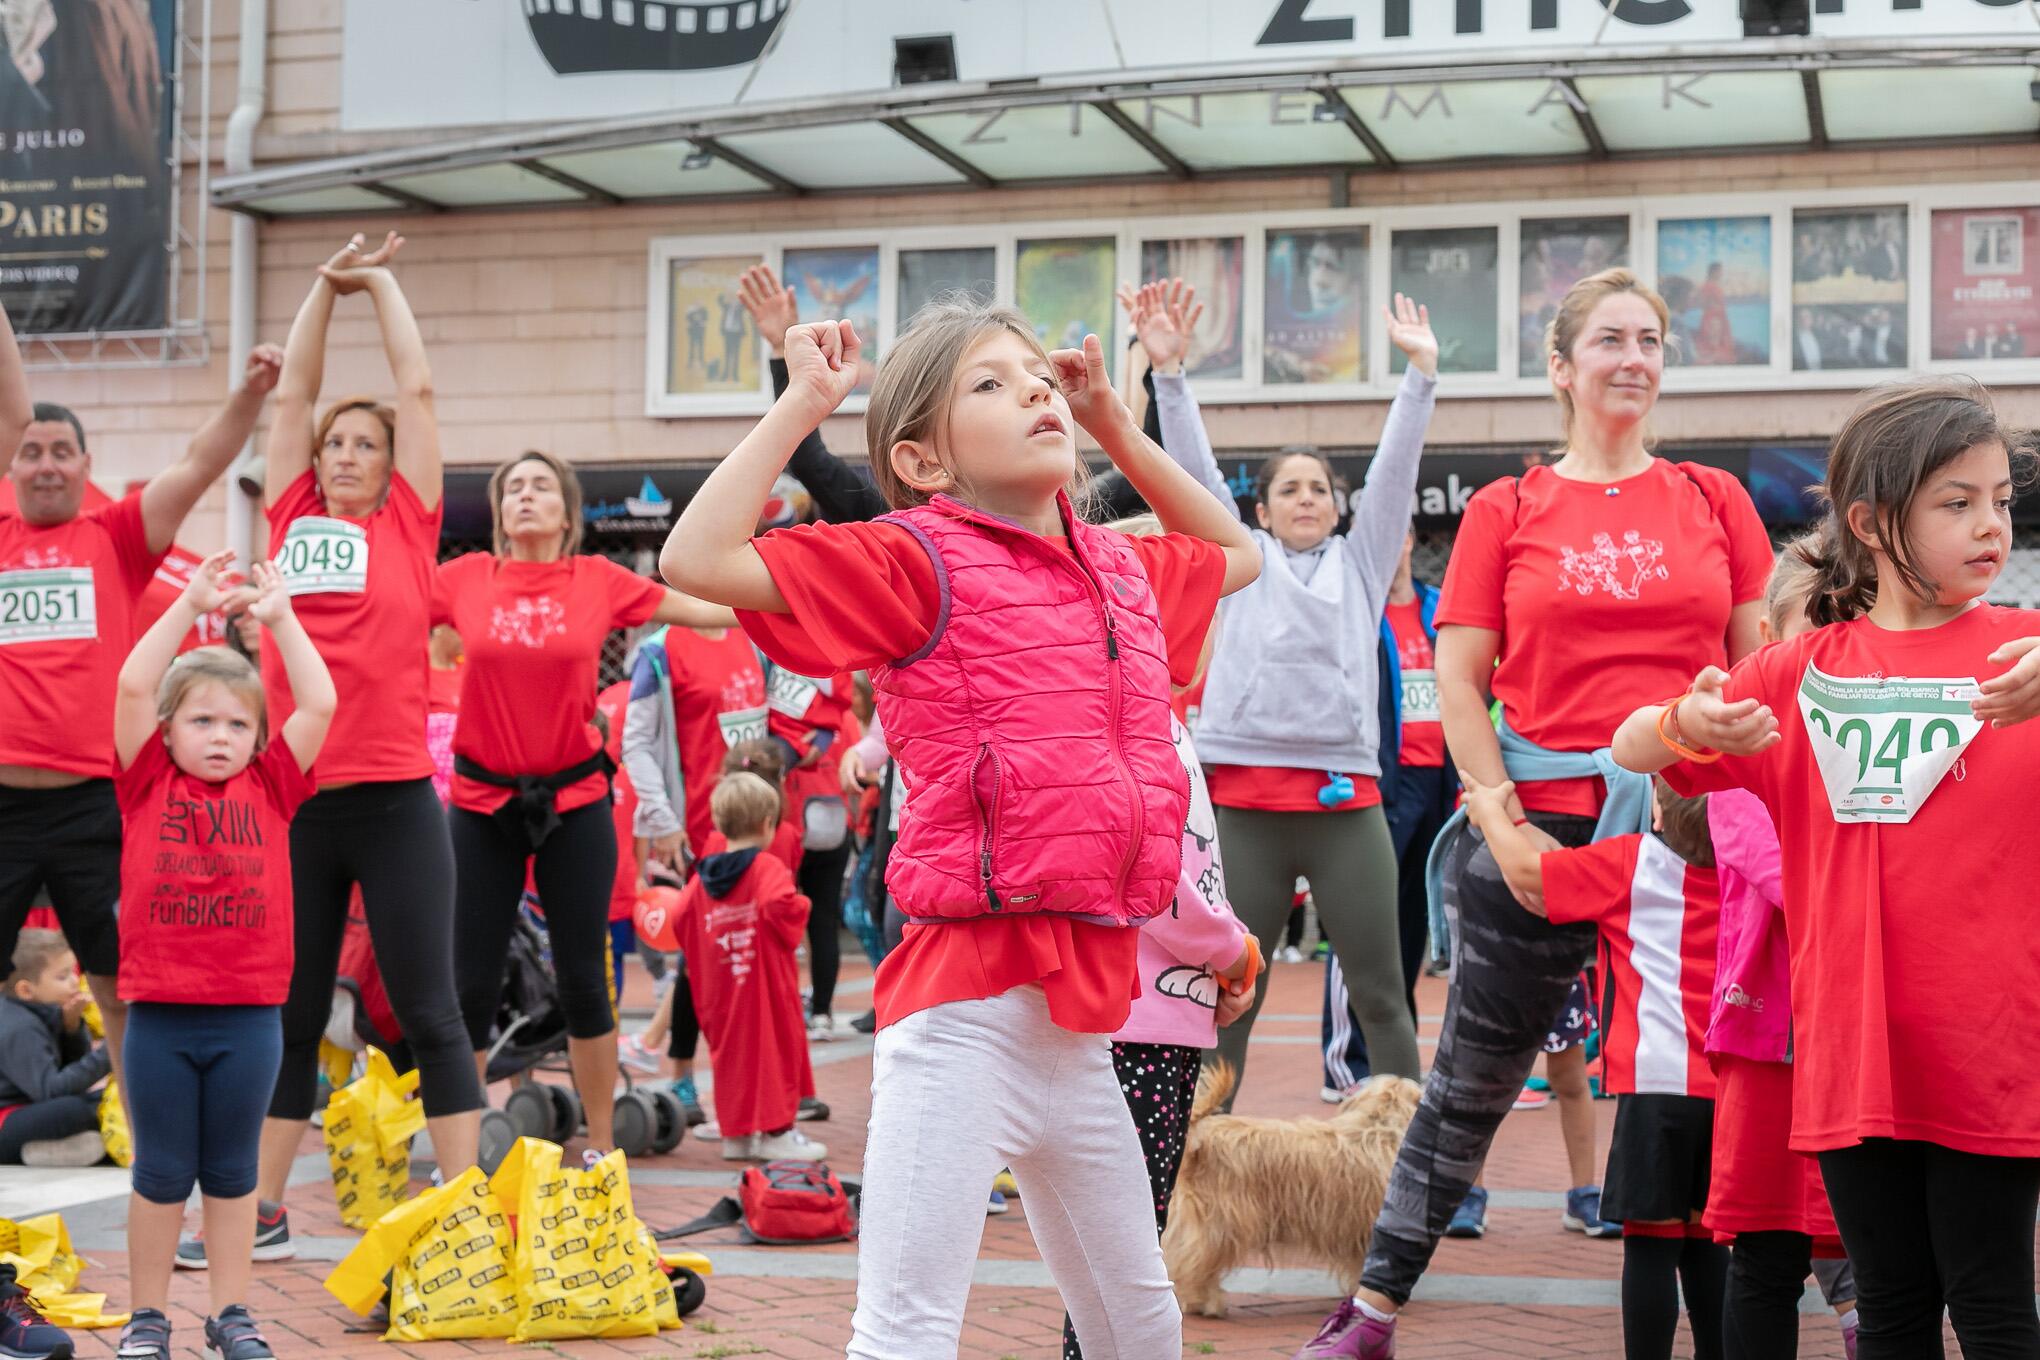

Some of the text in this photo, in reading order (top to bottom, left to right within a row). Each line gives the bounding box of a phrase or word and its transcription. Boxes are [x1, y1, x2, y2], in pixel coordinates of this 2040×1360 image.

[14, 128, 85, 153] JULIO
[281, 537, 356, 576] 2049
[3, 589, 78, 623] 2051
[149, 894, 266, 929] runBIKErun
